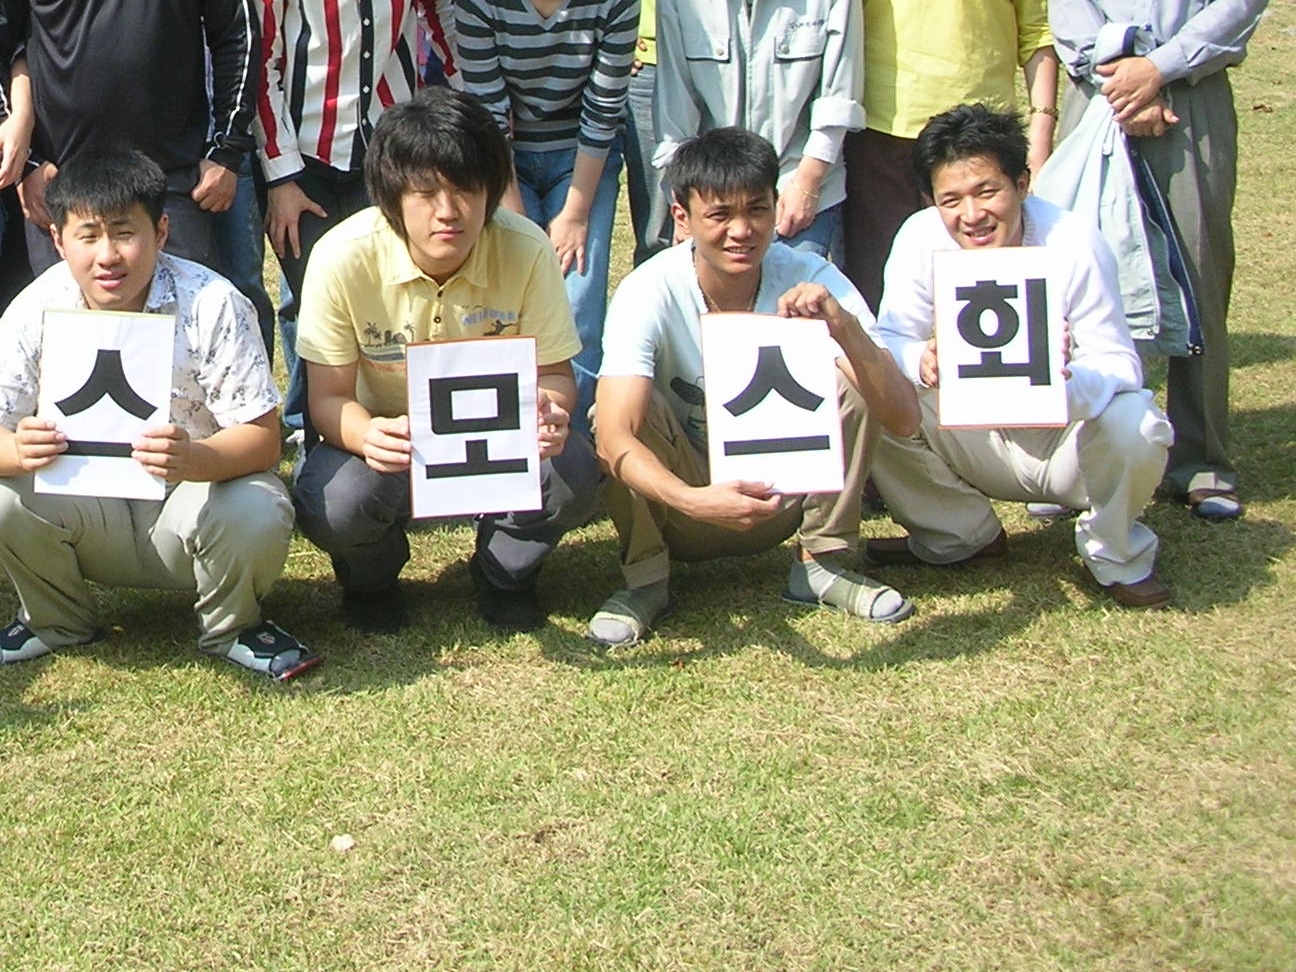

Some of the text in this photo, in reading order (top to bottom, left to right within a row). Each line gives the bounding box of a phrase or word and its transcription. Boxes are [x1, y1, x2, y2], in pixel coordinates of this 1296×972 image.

[956, 278, 1051, 386] 회
[53, 349, 158, 459] 스
[425, 371, 529, 480] 모
[722, 344, 830, 457] 스
